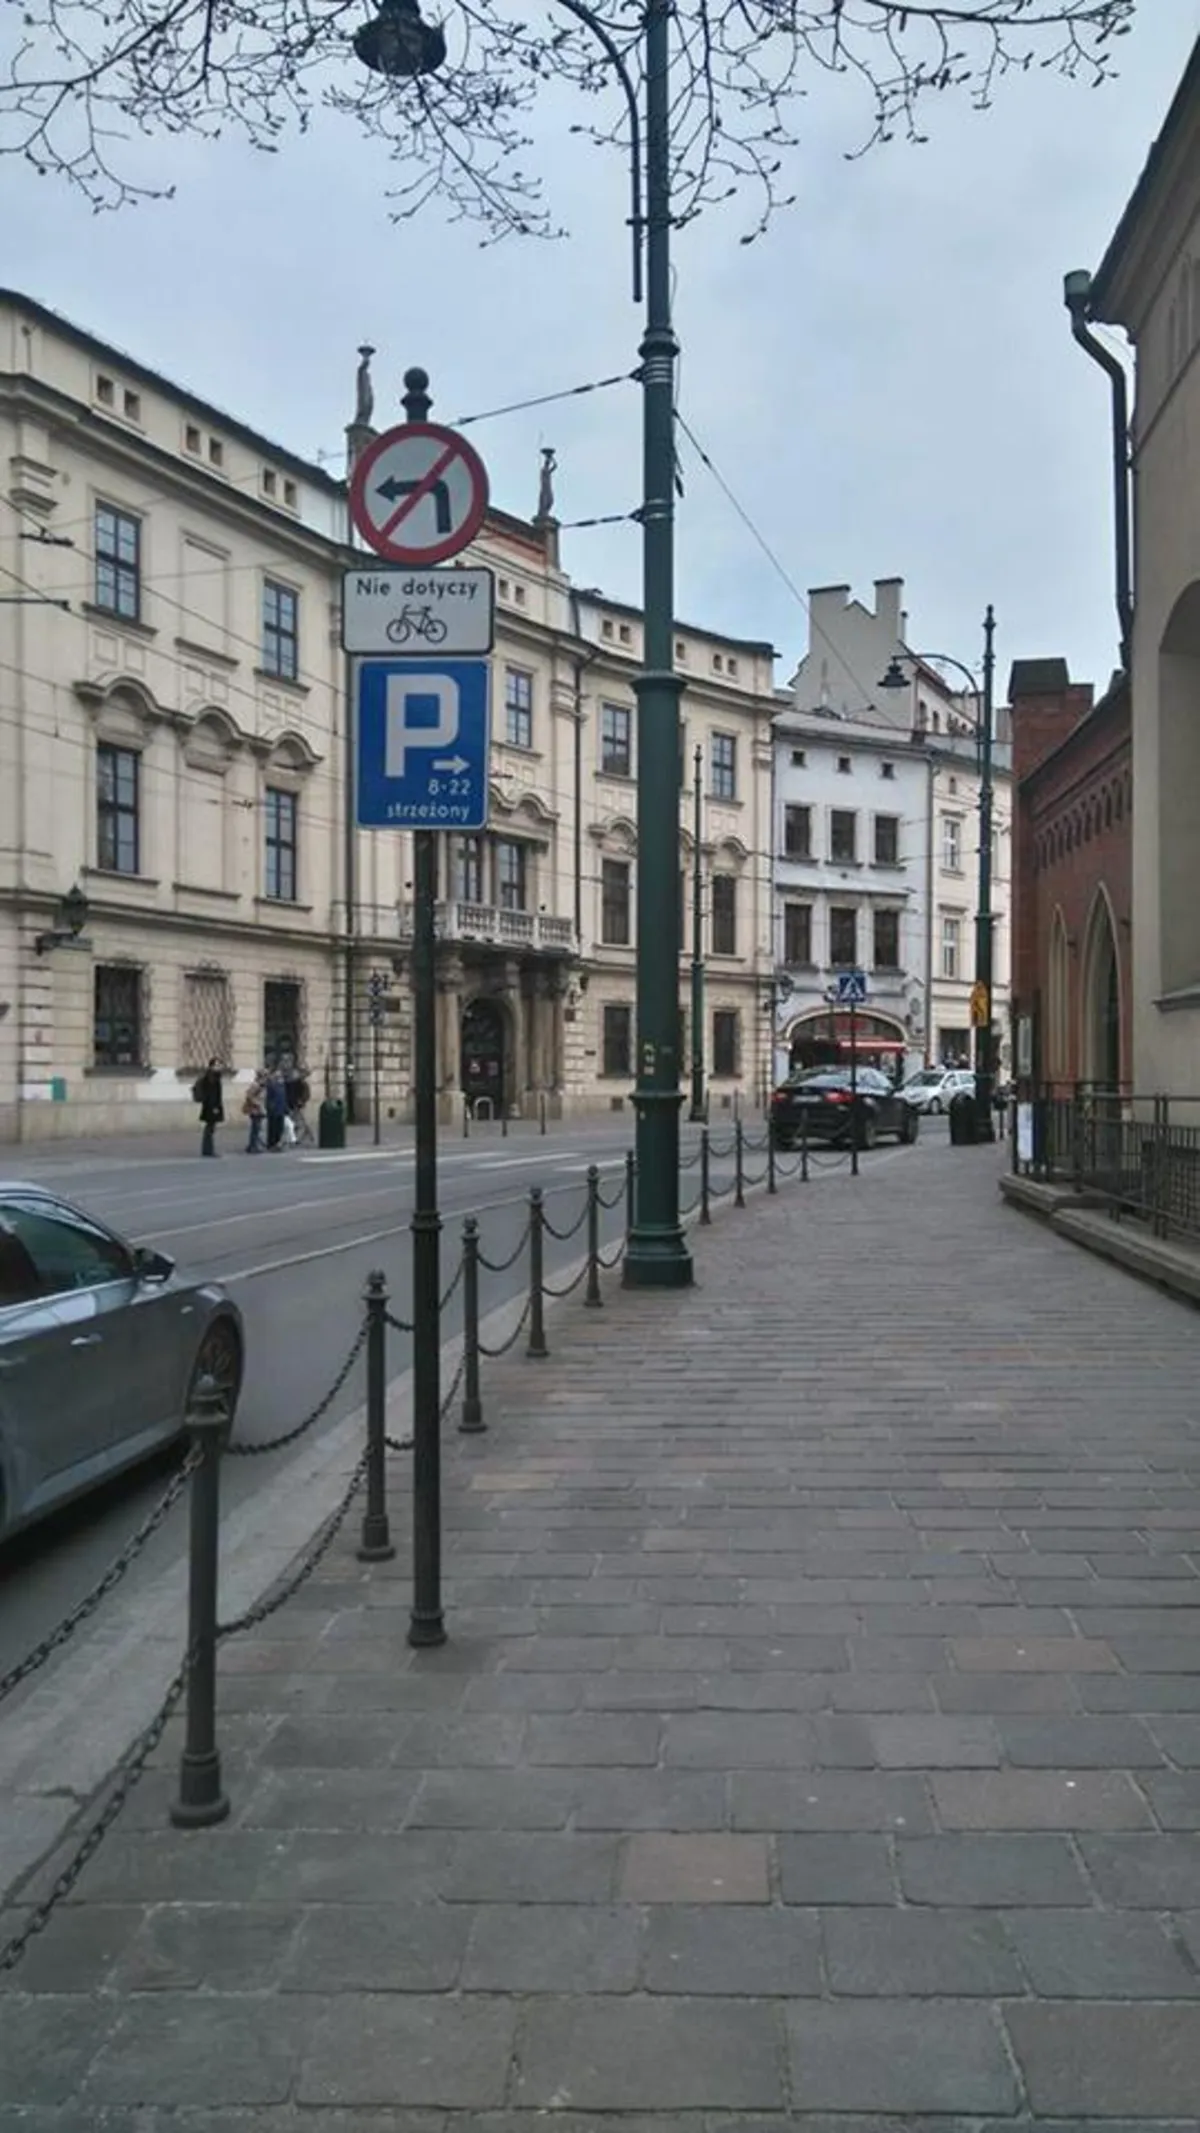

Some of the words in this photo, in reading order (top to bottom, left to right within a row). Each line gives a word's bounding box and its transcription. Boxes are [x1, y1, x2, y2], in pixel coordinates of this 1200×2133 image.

[356, 577, 391, 596] Nie
[402, 577, 478, 600] dotyczy
[385, 673, 460, 778] P
[428, 779, 471, 796] 8-22
[387, 801, 470, 821] strzeżony
